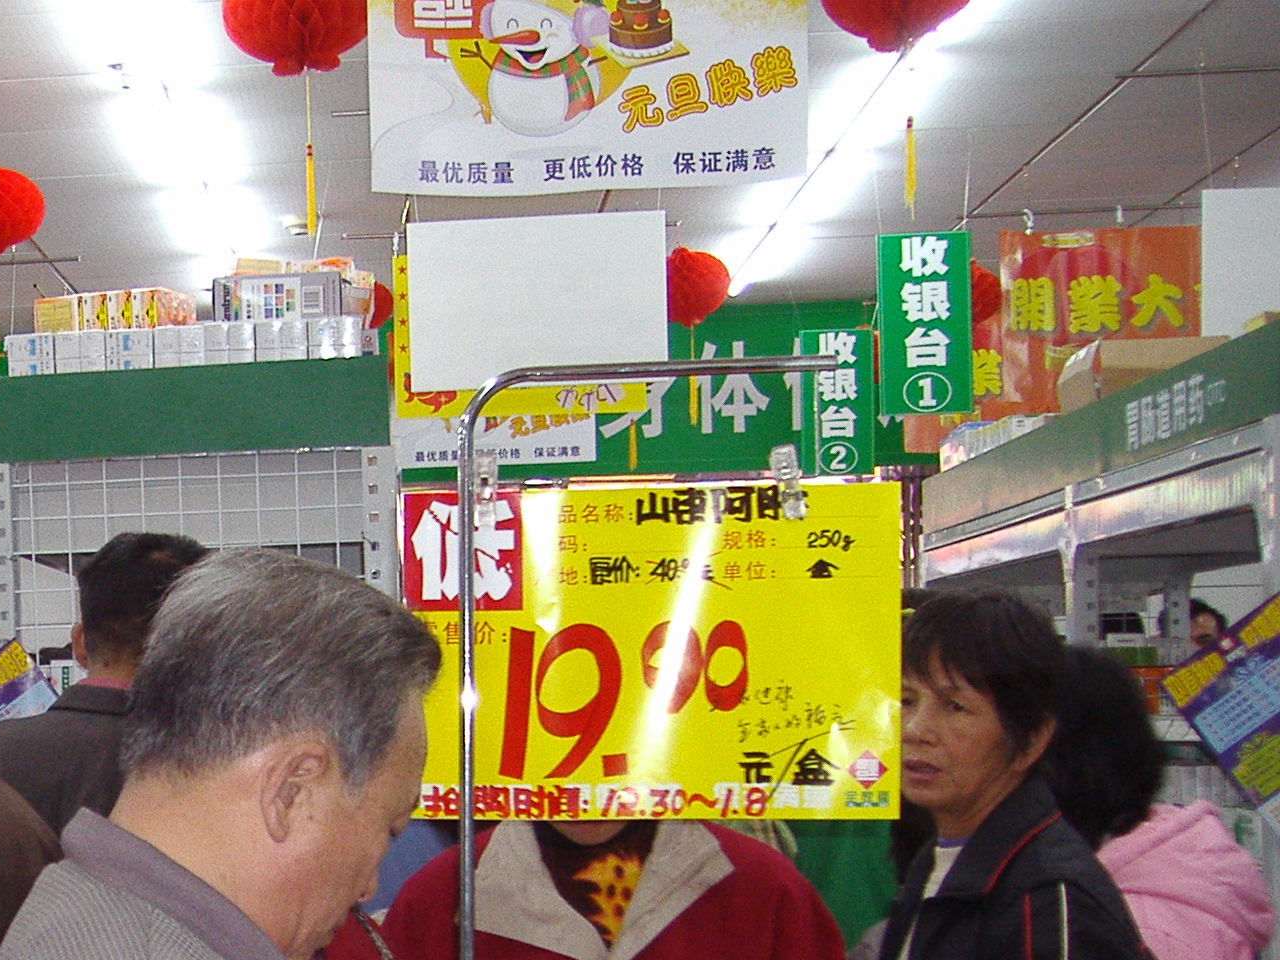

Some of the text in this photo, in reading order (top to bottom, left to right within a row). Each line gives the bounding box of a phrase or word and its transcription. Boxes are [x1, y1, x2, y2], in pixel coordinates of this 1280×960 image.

[419, 147, 776, 185] 最优质量 更低价格 保证满意
[1010, 273, 1201, 334] 開業大
[723, 530, 856, 551] 规格: 250g
[723, 562, 776, 581] 单位:
